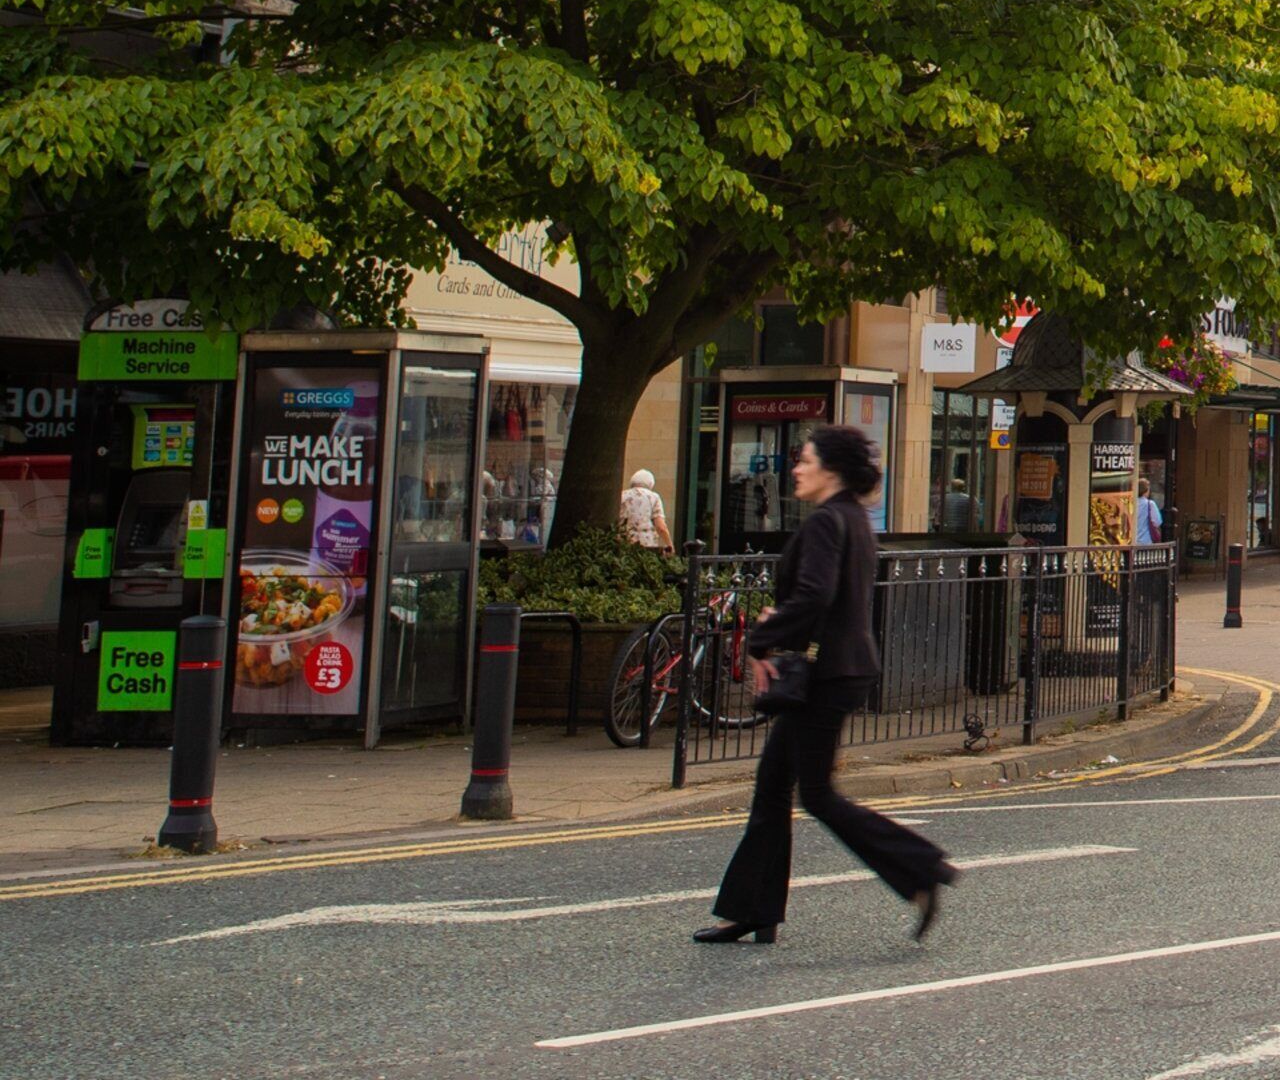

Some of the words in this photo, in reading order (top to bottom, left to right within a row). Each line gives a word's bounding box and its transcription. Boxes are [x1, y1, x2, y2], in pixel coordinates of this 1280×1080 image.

[437, 274, 470, 294] Cards
[473, 280, 494, 298] and
[107, 310, 154, 328] Free
[162, 308, 201, 328] Cas
[123, 338, 196, 354] Machine
[933, 338, 963, 352] M&S
[126, 358, 190, 374] Service
[297, 391, 351, 405] GREGGS
[737, 400, 767, 414] Coins
[767, 402, 777, 414] &
[777, 400, 809, 413] Cards
[264, 440, 288, 453] WE
[289, 435, 364, 458] MAKE
[262, 459, 363, 486] LUNCH
[257, 506, 280, 515] NEW
[187, 545, 203, 553] Free
[111, 647, 165, 668] Free
[106, 673, 166, 694] Cash
[318, 667, 341, 688] £3
